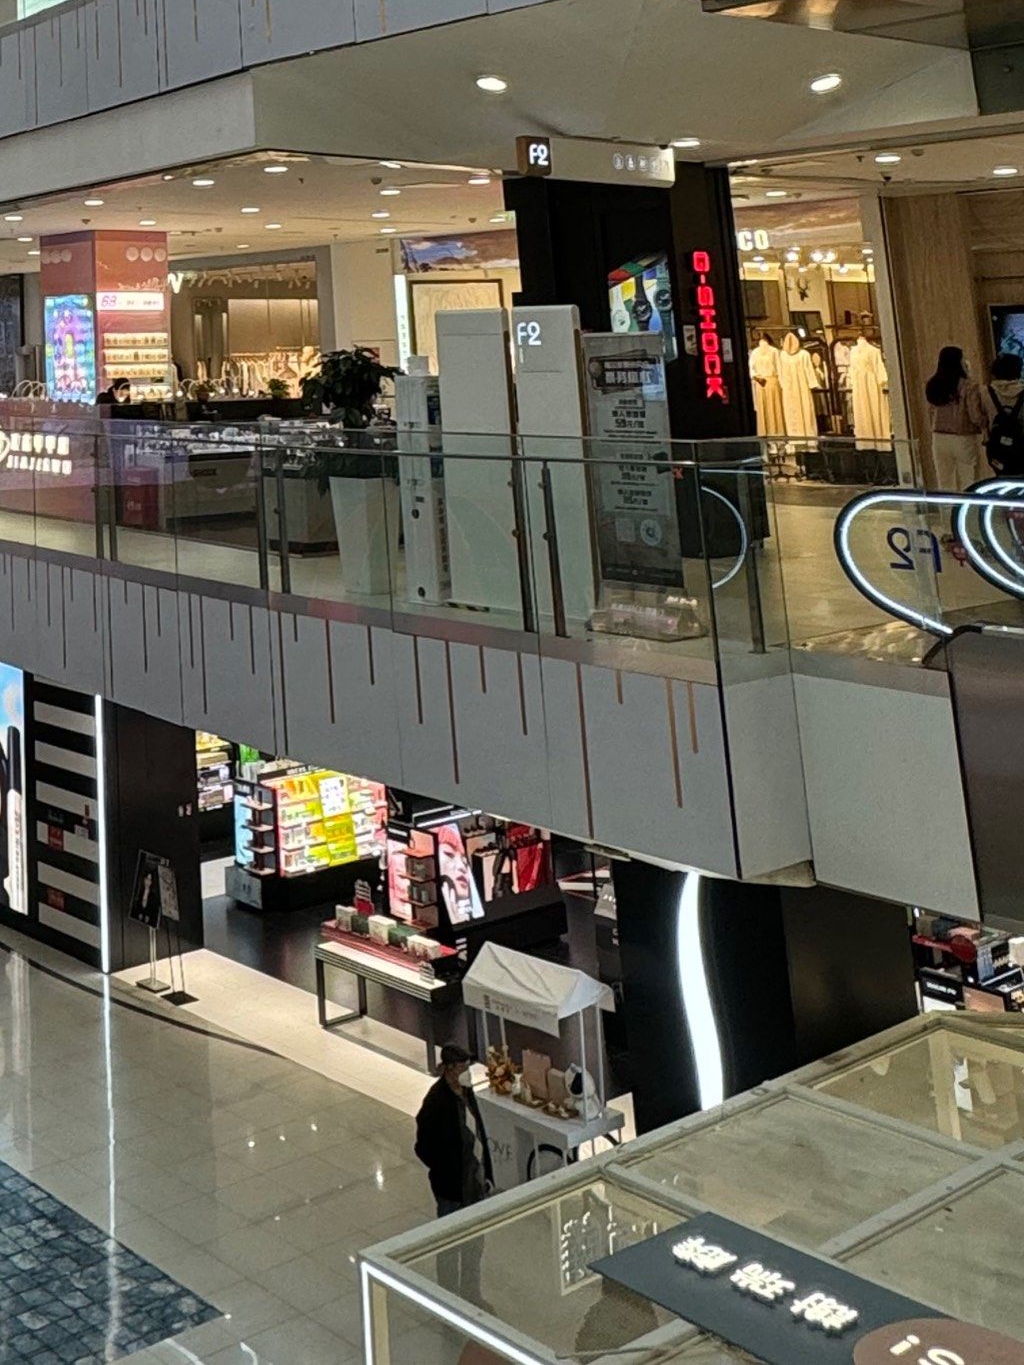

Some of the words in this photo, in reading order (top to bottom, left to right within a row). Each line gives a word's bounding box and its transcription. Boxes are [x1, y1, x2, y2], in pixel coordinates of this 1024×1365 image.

[528, 143, 549, 166] F2
[516, 321, 542, 346] F2
[692, 250, 725, 399] G-SHOCK
